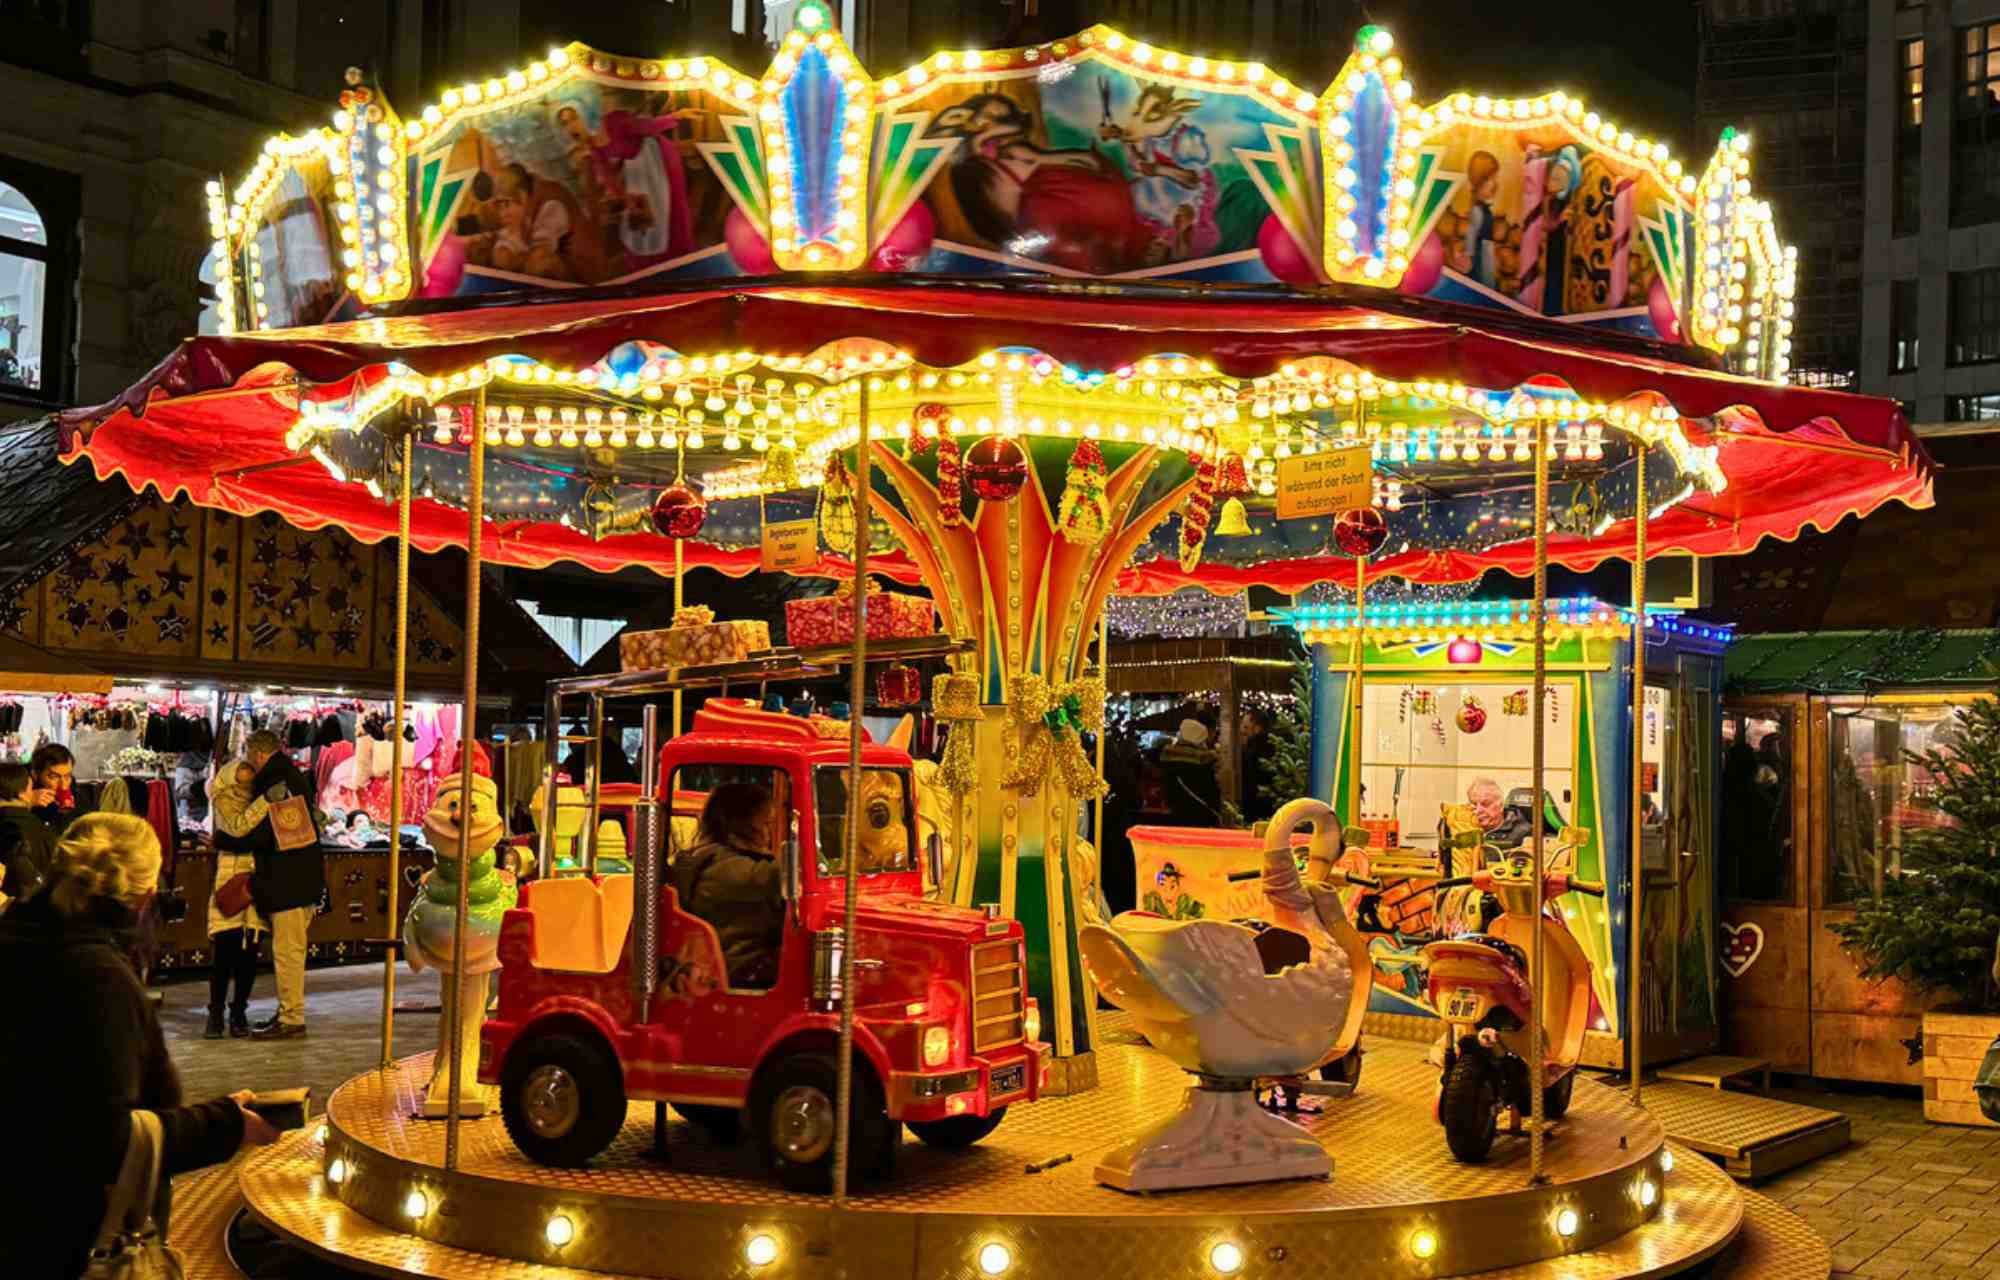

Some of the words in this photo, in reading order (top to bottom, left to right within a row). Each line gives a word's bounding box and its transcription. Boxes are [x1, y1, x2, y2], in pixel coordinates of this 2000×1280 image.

[1303, 461, 1322, 472] Bitte
[1325, 458, 1345, 469] nicht
[1286, 476, 1323, 492] während
[1325, 476, 1340, 488] der
[1342, 473, 1364, 485] Fahrt
